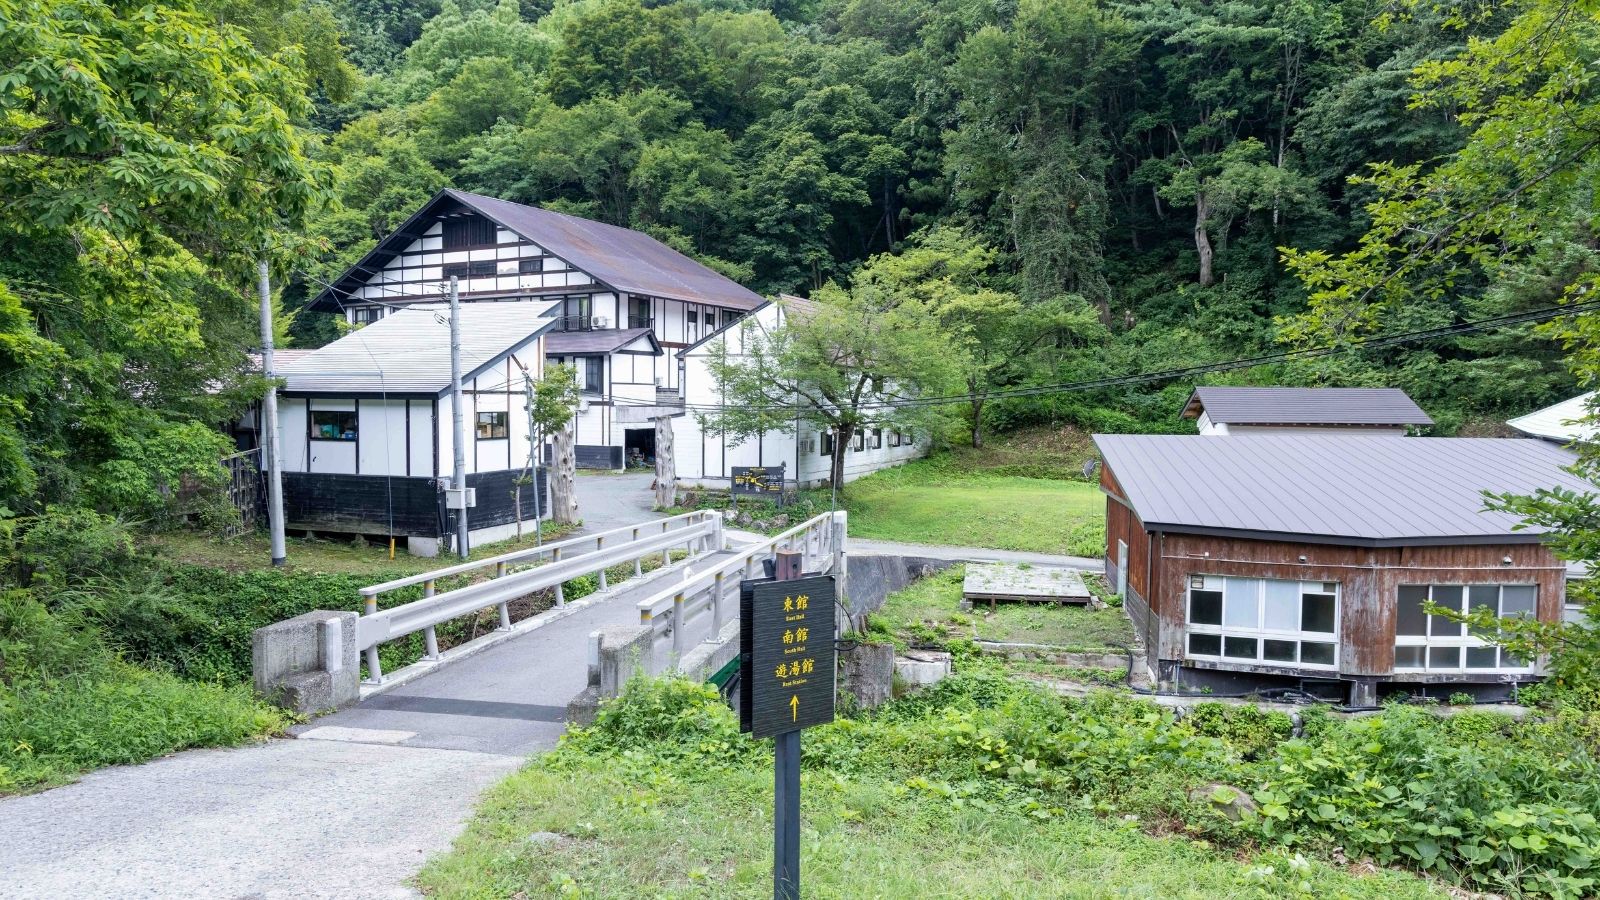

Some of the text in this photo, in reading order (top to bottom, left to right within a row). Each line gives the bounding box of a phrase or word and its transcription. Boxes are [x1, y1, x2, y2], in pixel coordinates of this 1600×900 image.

[784, 595, 808, 612] 東館
[783, 628, 808, 644] 南館
[775, 659, 814, 678] 遊湯館
